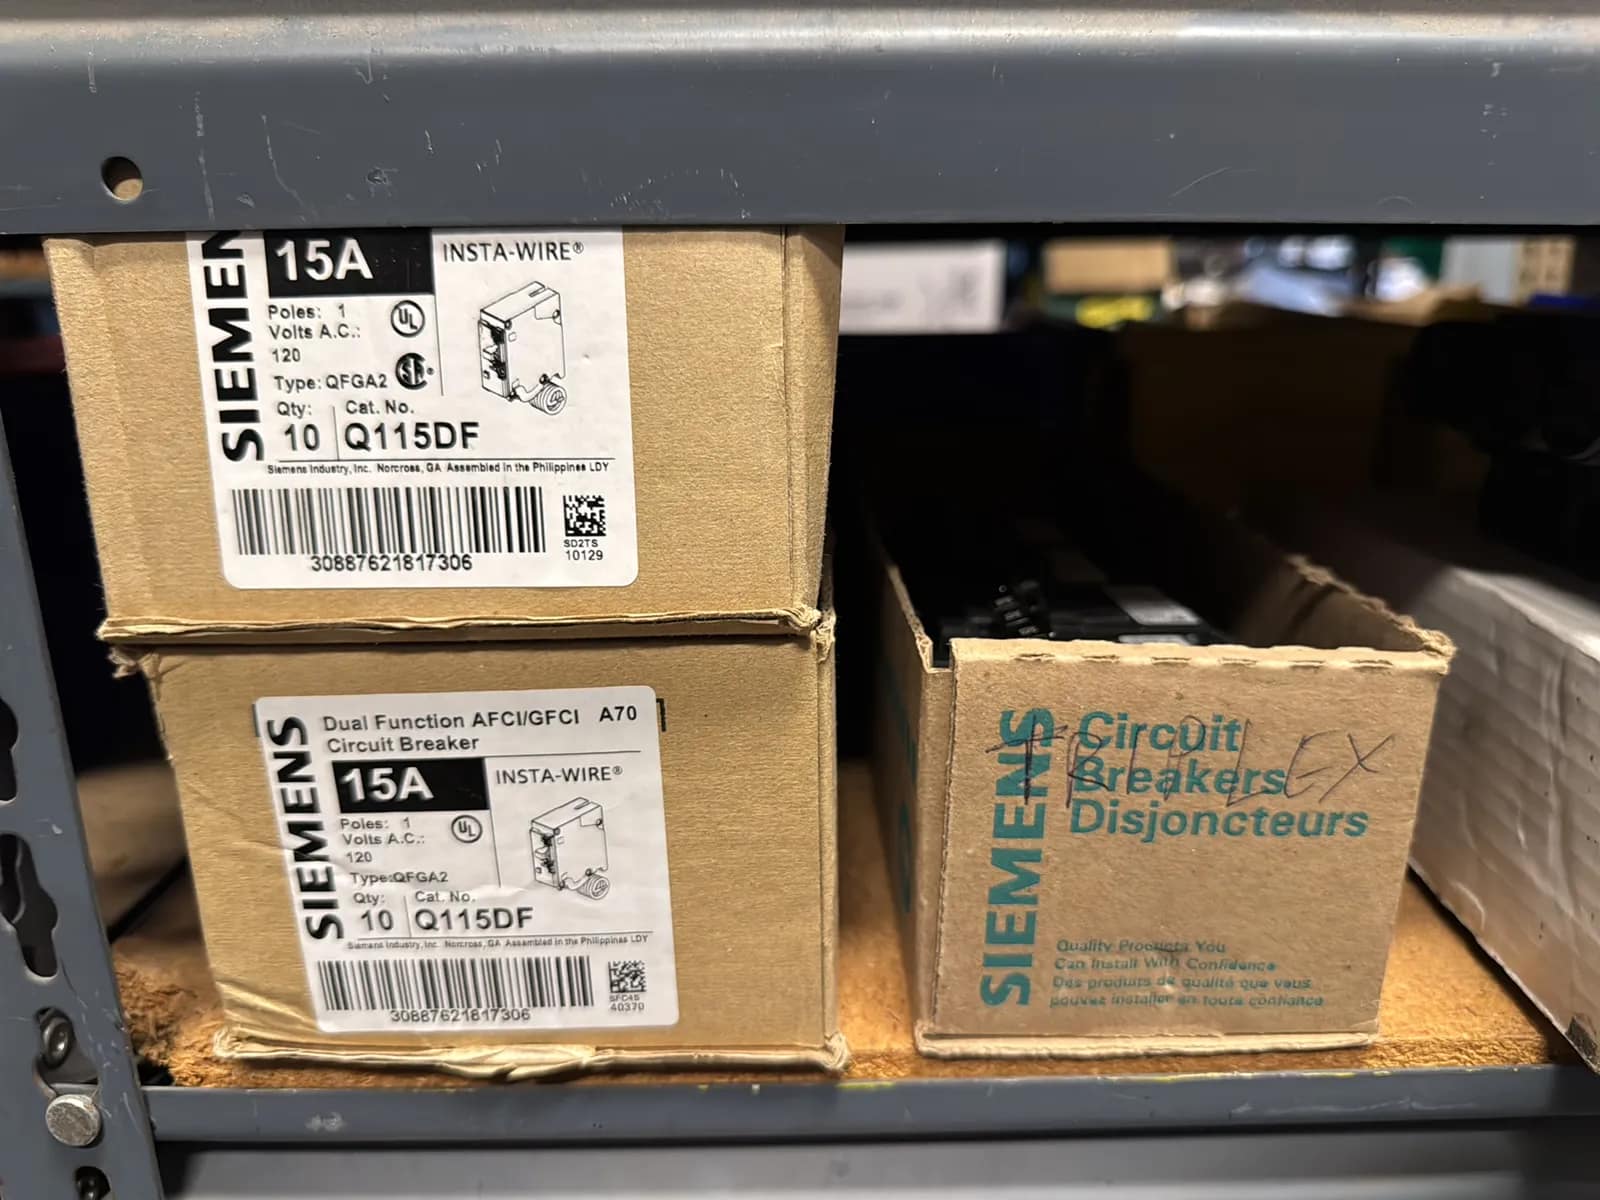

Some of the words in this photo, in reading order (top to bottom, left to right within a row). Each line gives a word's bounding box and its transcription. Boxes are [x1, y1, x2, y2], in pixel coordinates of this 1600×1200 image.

[276, 238, 374, 281] 15A
[268, 304, 321, 319] Poles:
[338, 303, 345, 318] 1
[269, 325, 313, 340] Volts
[319, 324, 360, 339] A.C.:
[202, 231, 264, 461] SIEMEN
[272, 348, 301, 362] 120
[274, 375, 321, 392] Type:
[326, 374, 388, 389] QFGA2
[277, 401, 313, 419] Qty:
[346, 400, 380, 415] Cat.
[385, 400, 415, 414] No.
[284, 423, 320, 451] 10
[344, 421, 479, 452] Q115DF
[267, 464, 307, 474] Siemens
[310, 463, 351, 476] Industry,
[354, 463, 372, 473] Inc.
[426, 463, 441, 473] GA
[447, 463, 500, 473] Assembled
[503, 463, 512, 472] in
[514, 463, 530, 472] the
[533, 462, 586, 474] Philippines
[589, 462, 609, 472] LDY
[563, 539, 599, 548] SD2TS
[310, 553, 473, 572] 30887621817306
[566, 550, 604, 561] 10129
[323, 715, 368, 731] Dual
[374, 712, 464, 730] Function
[472, 709, 579, 727] AFCI/GFCI
[600, 706, 637, 722] A70
[1078, 711, 1242, 752] Circuit
[327, 737, 394, 753] Circuit
[400, 735, 479, 751] Breaker
[340, 766, 434, 801] 15A
[1073, 757, 1286, 795] Breakers
[267, 715, 344, 940] SIEMENS
[340, 818, 389, 830] Poles:
[403, 817, 410, 828] 1
[1069, 797, 1369, 843] Disjoncteurs
[342, 833, 382, 845] Volts
[345, 852, 372, 863] 120
[980, 707, 1054, 1006] SIEMENS
[353, 893, 385, 905] Qty:
[415, 891, 445, 902] Cat.
[450, 891, 475, 902] No.
[361, 909, 394, 931] 10
[415, 907, 533, 932] Q115DF
[565, 937, 578, 946] the
[581, 936, 627, 947] Philippines
[1056, 940, 1112, 953] Quality
[1195, 941, 1225, 953] You
[1055, 958, 1085, 969] Can
[1091, 958, 1137, 969] Install
[1186, 958, 1277, 971] Confidence
[1240, 979, 1269, 991] que
[391, 1008, 530, 1022] 30887621817306
